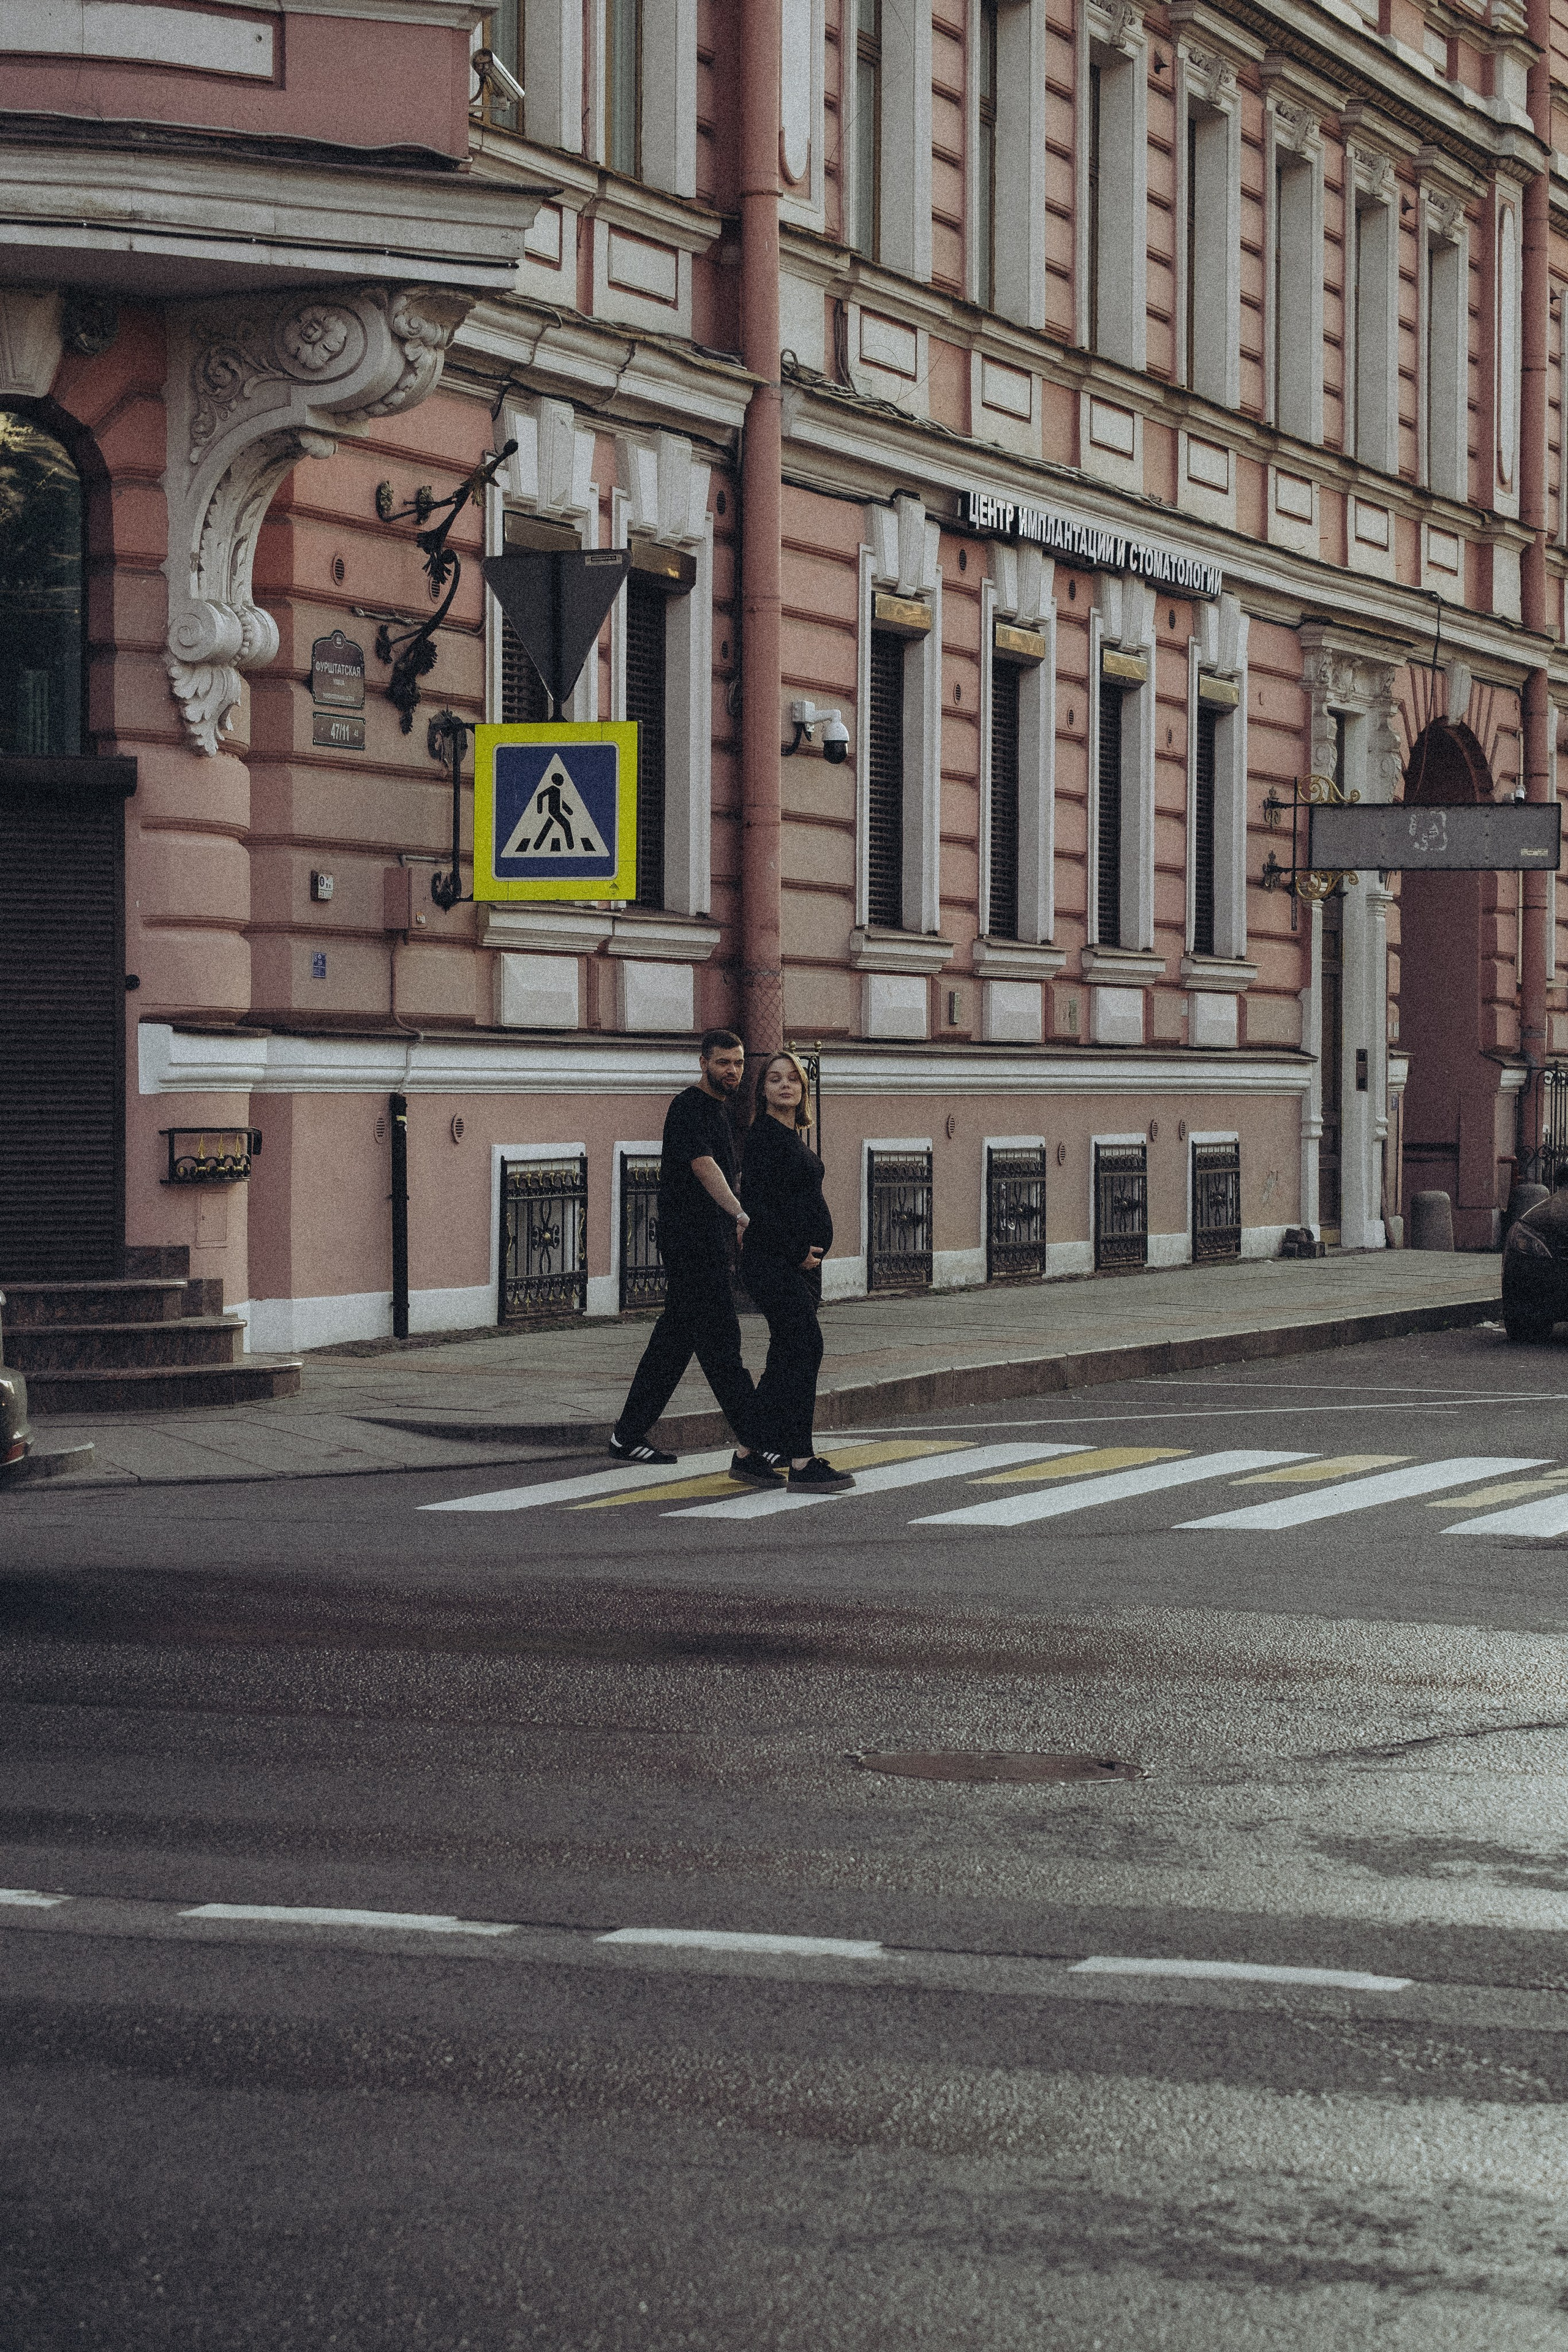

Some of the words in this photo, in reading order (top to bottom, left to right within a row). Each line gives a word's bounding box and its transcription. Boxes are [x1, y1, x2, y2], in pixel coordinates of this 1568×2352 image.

[969, 491, 1014, 533] ЦЕНТР
[1019, 506, 1114, 564] ИМПЛАНТАЦИИ
[1117, 538, 1126, 567] И
[1129, 543, 1223, 595] СТОМАТОЛОГИИ
[315, 661, 361, 677] ФУРШТАТСКАЯ
[331, 723, 349, 741] 47/11
